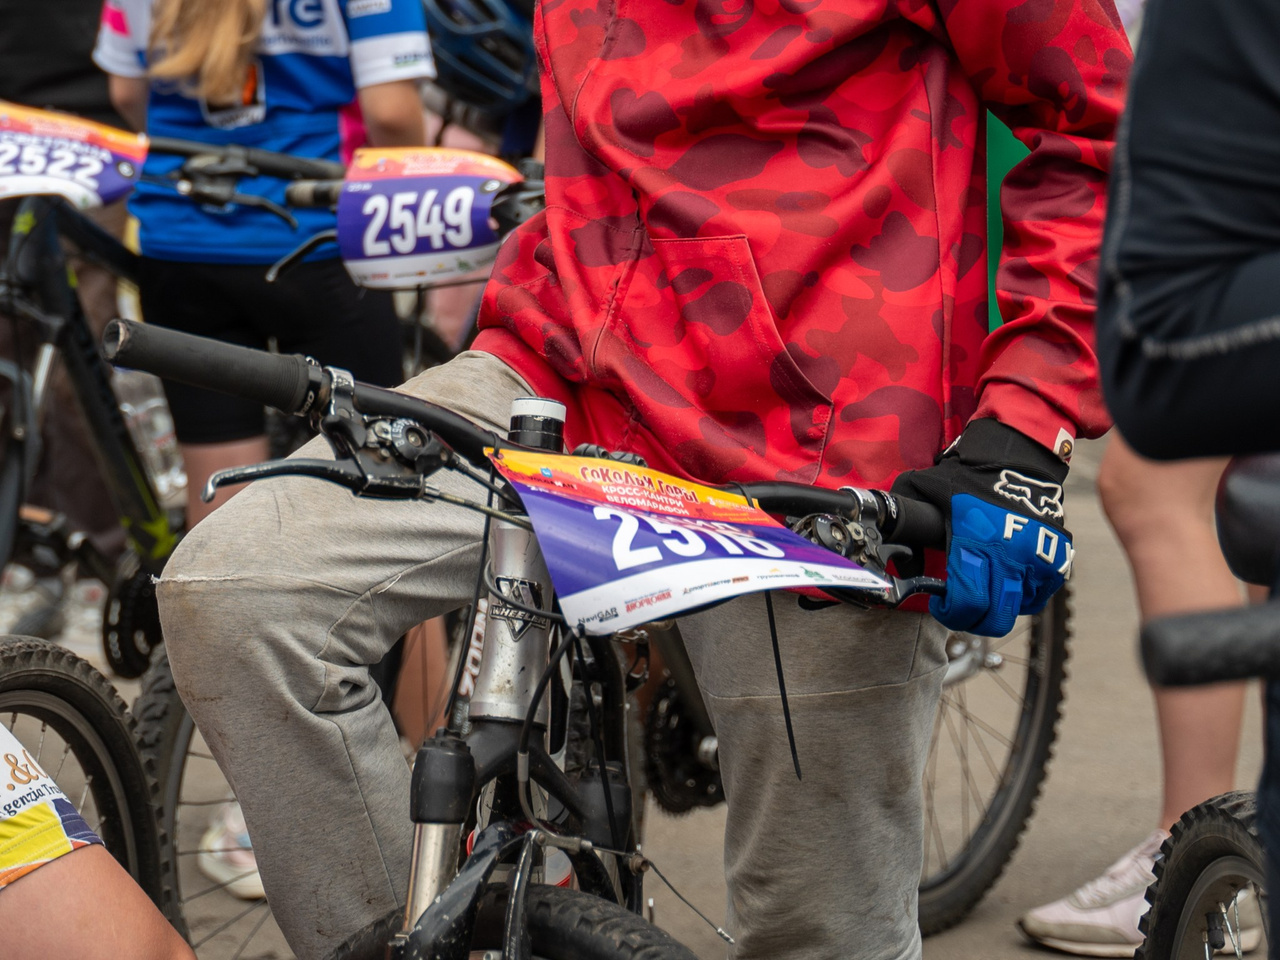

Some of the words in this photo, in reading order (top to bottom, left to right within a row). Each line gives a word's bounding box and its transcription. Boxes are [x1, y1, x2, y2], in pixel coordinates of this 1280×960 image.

[362, 185, 475, 257] 2549
[580, 466, 655, 490] СОКОЛЬИ
[657, 478, 700, 504] ГОРЫ
[601, 484, 685, 509] КРОСС-КАНТРИ
[606, 495, 690, 516] ВЕЛОМАРАФОН
[1002, 512, 1077, 581] FOX
[490, 604, 548, 627] WHEELER
